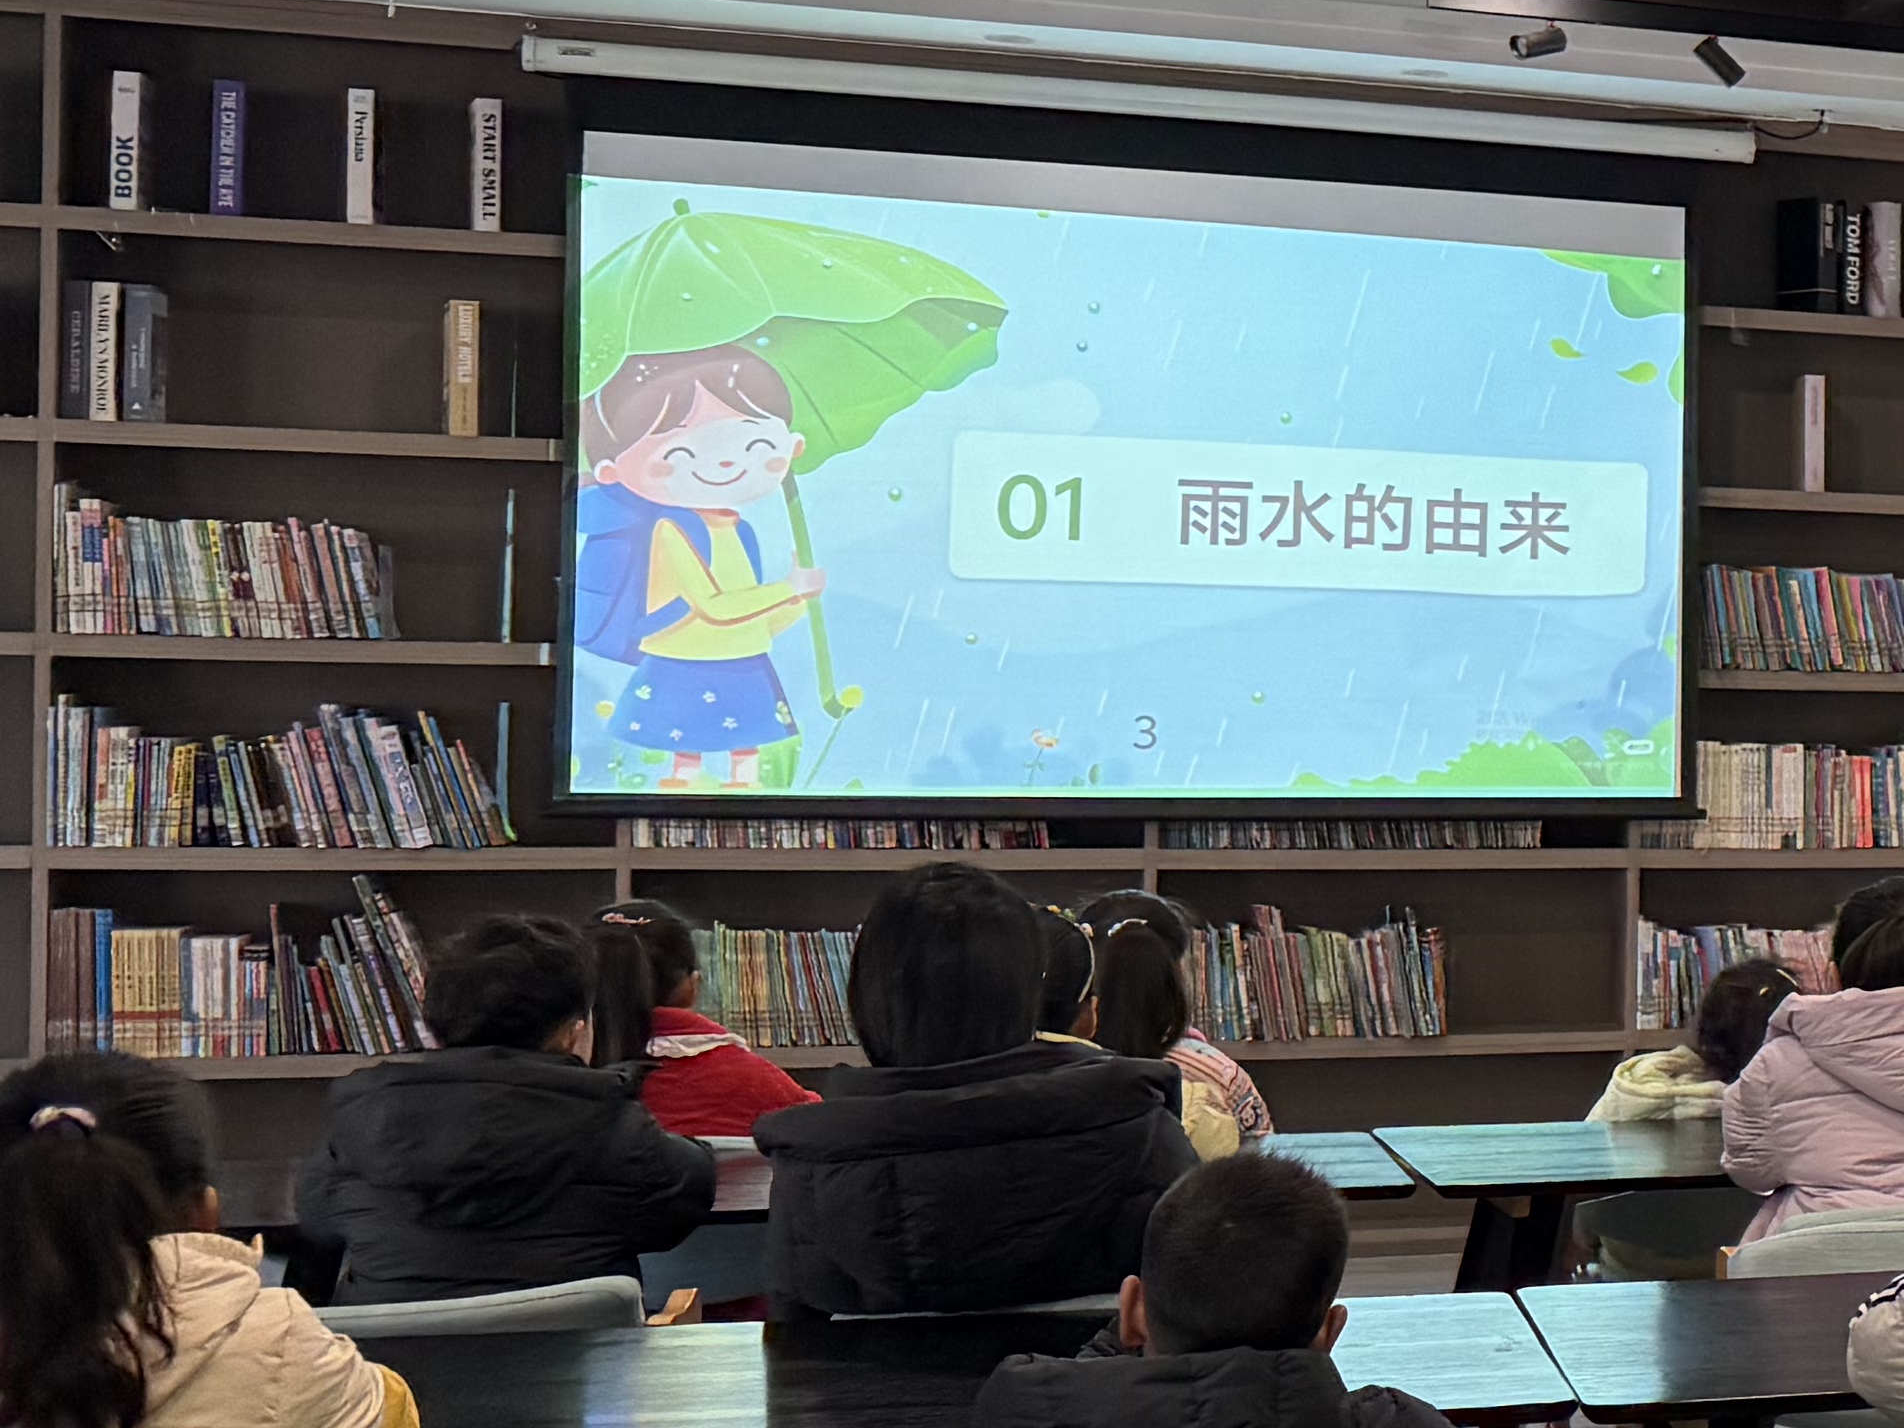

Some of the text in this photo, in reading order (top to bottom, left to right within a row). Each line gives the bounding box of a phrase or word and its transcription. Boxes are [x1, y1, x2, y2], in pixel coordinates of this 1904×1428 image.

[220, 91, 237, 111] THE
[114, 135, 135, 199] BOOK
[481, 112, 498, 222] START SMALL
[1845, 212, 1861, 305] TOM FORD
[95, 358, 110, 415] MONROE
[997, 474, 1083, 542] 01
[1177, 478, 1571, 560] 雨水的由来
[1132, 715, 1158, 750] 3
